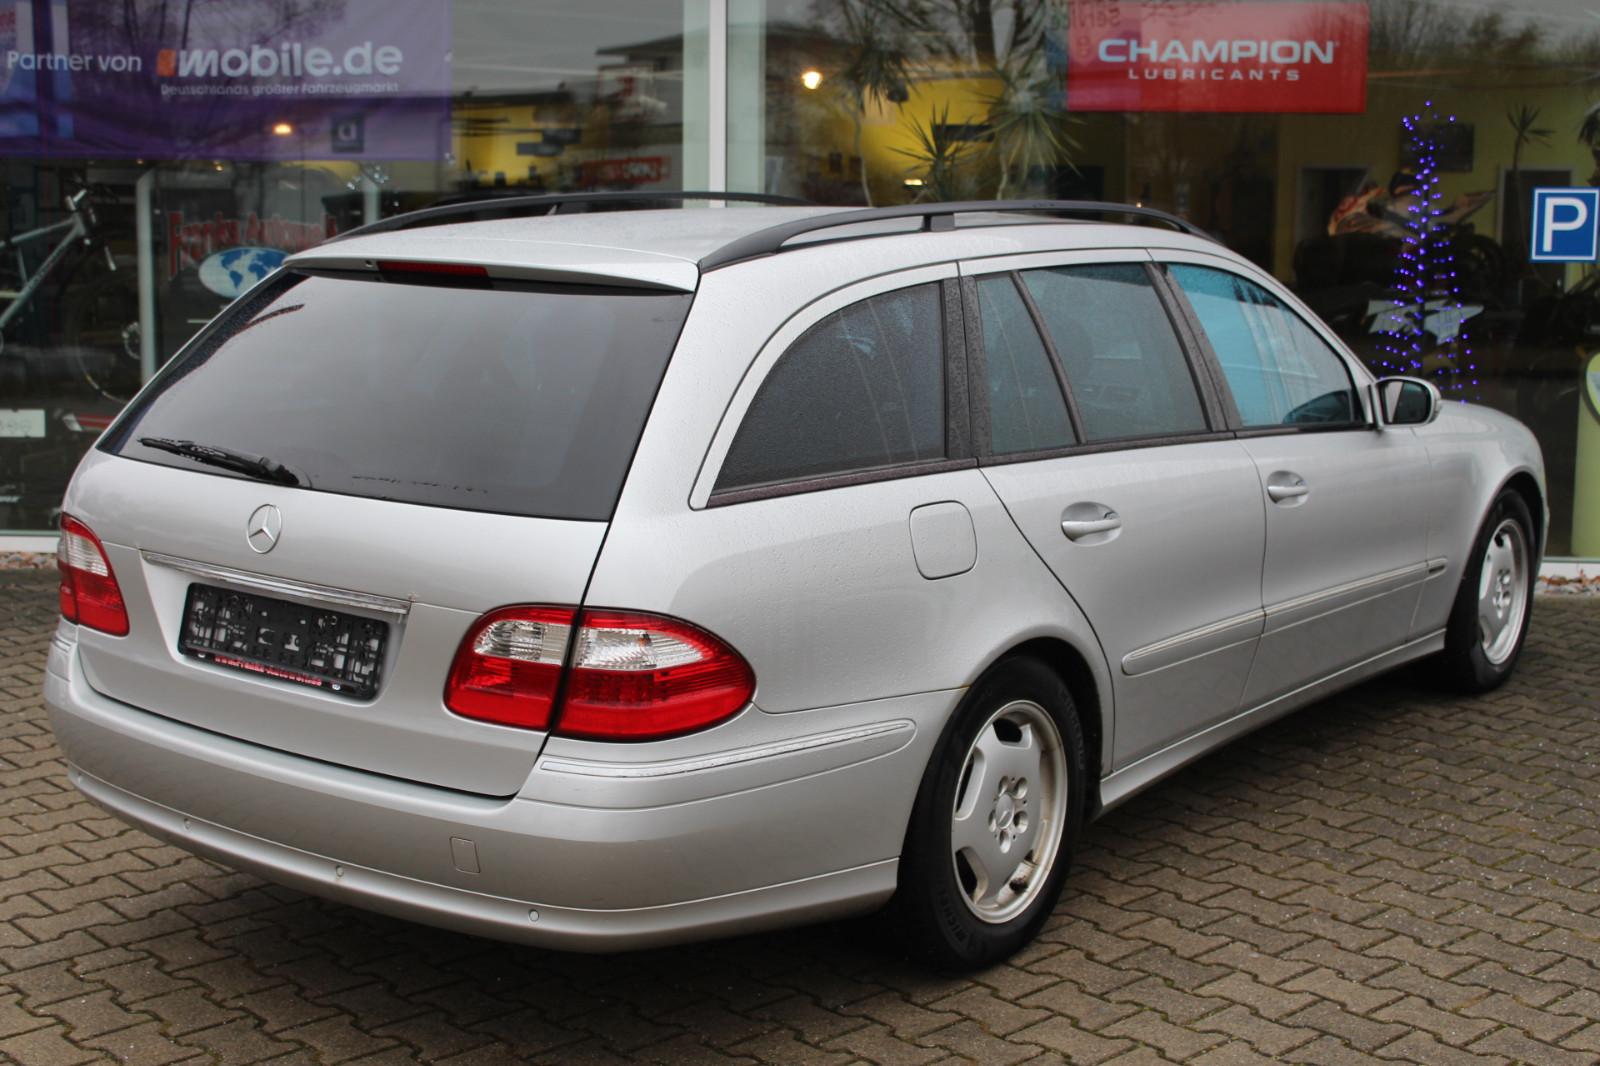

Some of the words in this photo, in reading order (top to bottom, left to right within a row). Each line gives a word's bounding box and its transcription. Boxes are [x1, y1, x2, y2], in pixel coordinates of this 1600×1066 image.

[8, 51, 92, 71] Partner
[99, 55, 141, 72] von
[178, 42, 403, 77] mobile.de
[1099, 39, 1334, 63] CHAMPION
[1128, 69, 1300, 80] LUBRICANTS
[161, 83, 248, 96] Deutschlands
[1543, 197, 1588, 252] P
